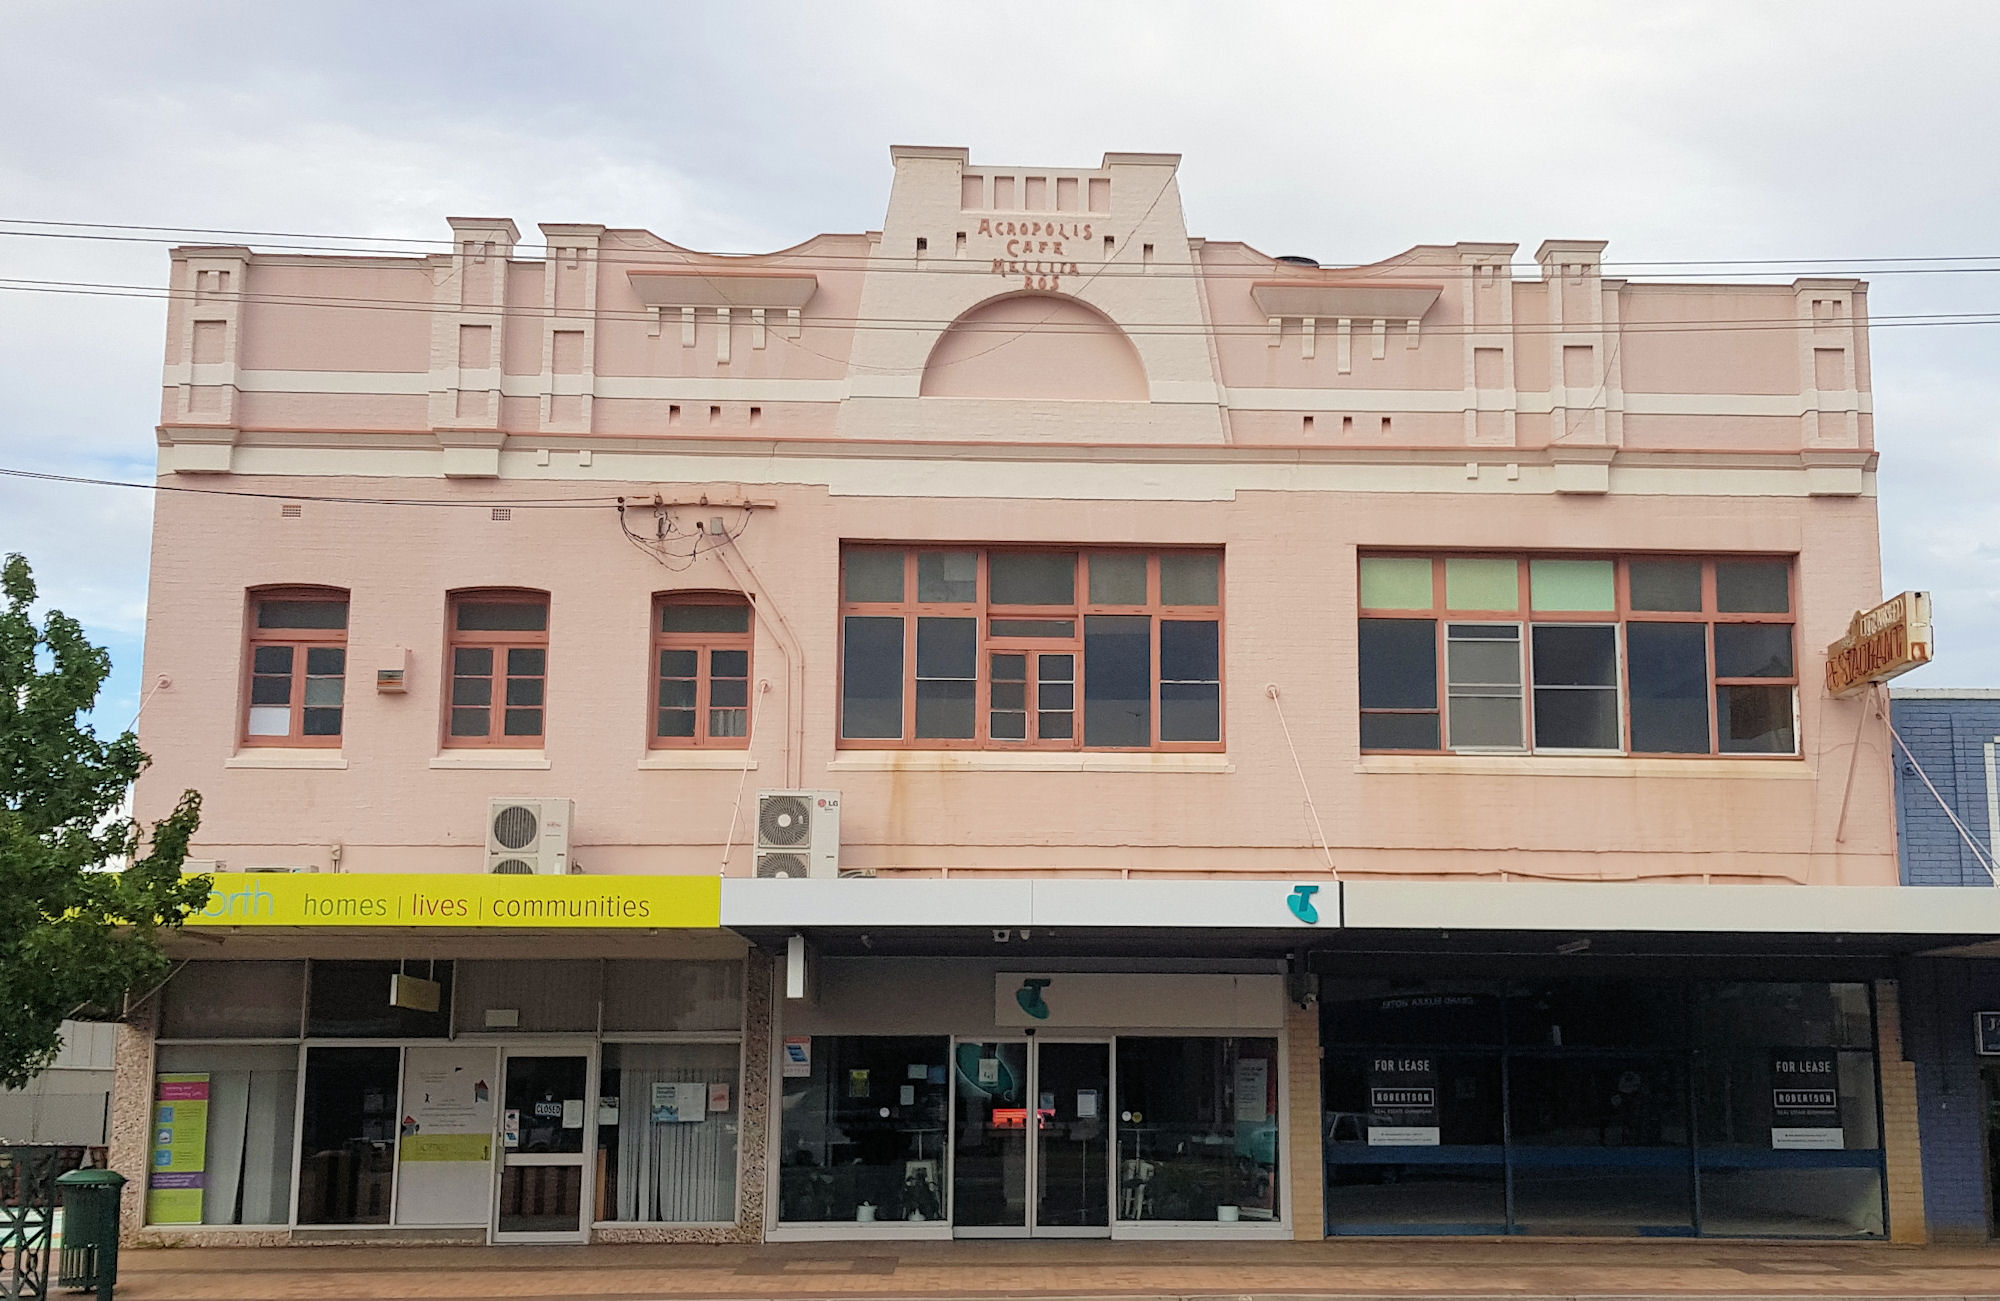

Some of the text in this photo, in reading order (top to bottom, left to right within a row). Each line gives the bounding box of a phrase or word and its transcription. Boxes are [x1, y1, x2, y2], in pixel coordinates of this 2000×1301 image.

[977, 218, 1093, 241] ACROPOLIS
[1006, 239, 1064, 258] CAFE
[196, 879, 650, 917] orth homes lives communities
[1374, 1059, 1431, 1072] FOR LEASE
[1775, 1061, 1832, 1073] FOR LEASE
[1376, 1092, 1430, 1102] ROBERTSON
[1778, 1093, 1832, 1103] ROBERTSON
[536, 1103, 561, 1114] CLOSED
